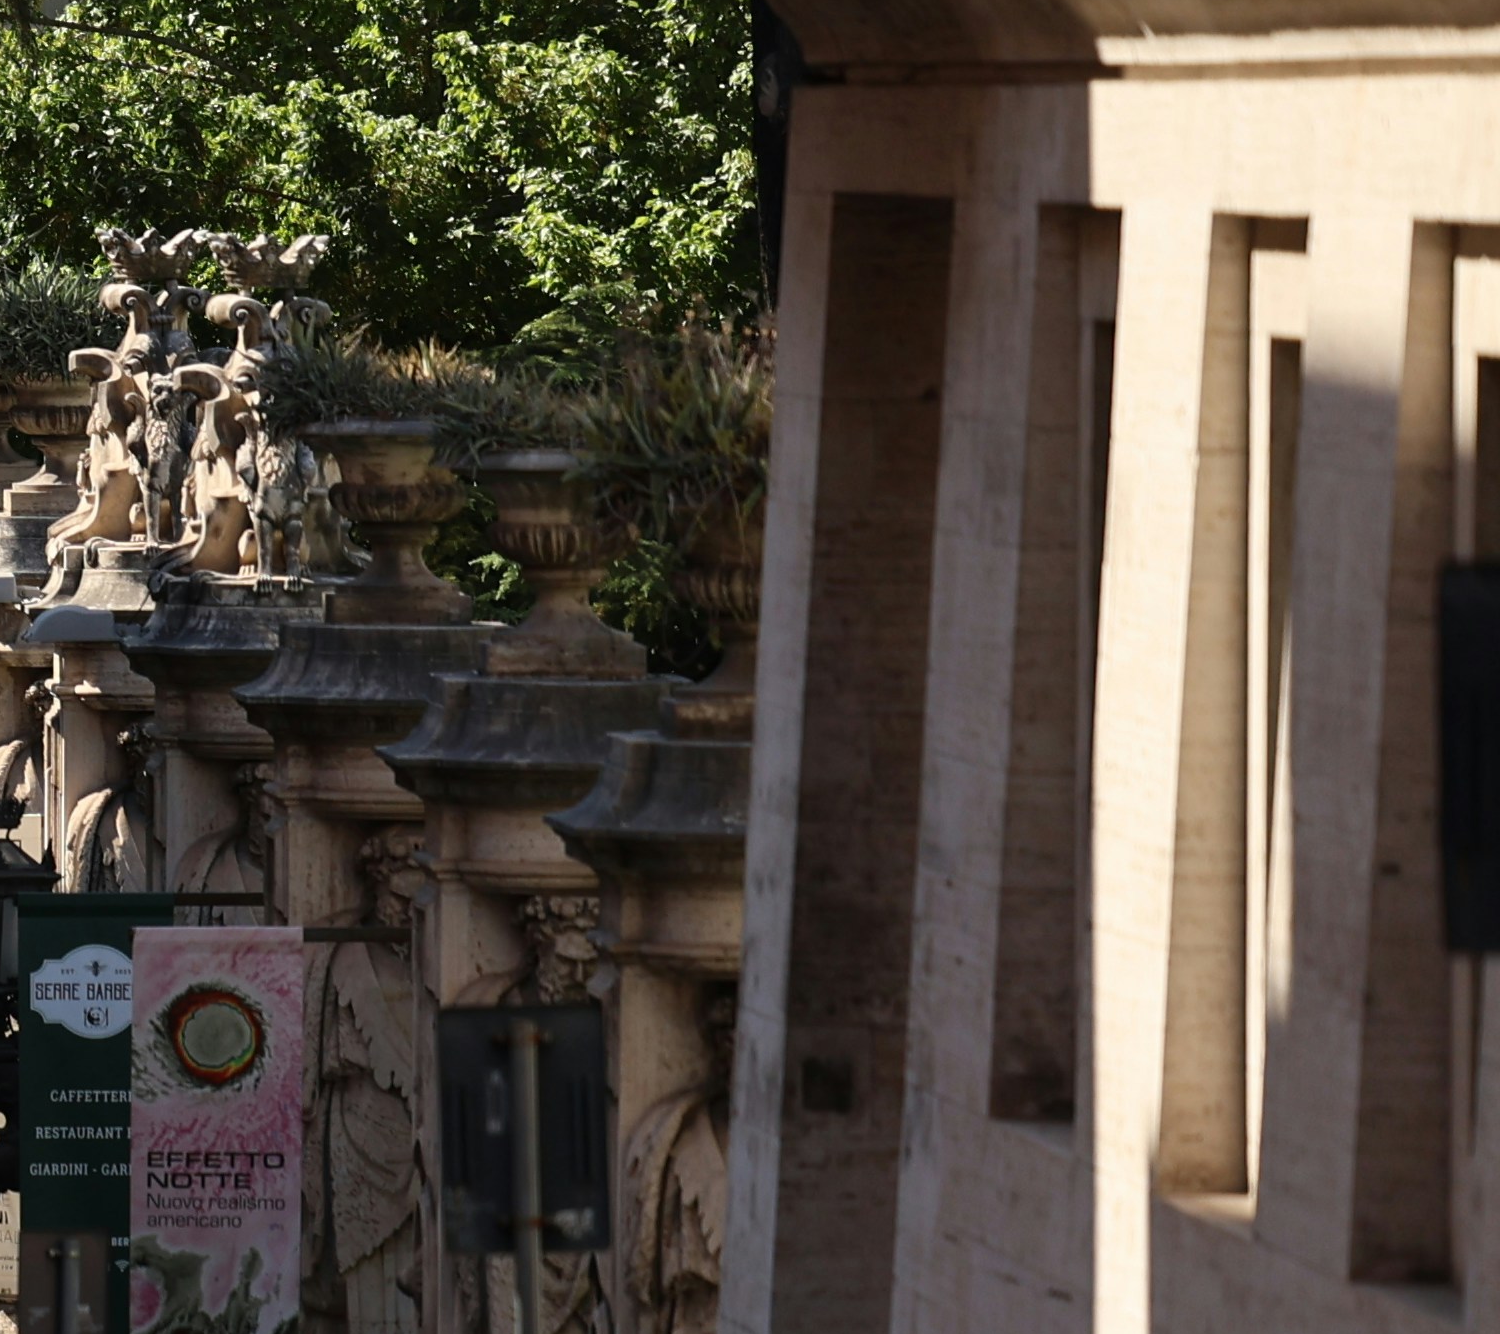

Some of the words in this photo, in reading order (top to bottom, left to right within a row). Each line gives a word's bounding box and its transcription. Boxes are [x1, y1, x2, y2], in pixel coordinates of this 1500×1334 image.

[35, 982, 80, 1001] SERRE
[35, 1126, 123, 1140] RESTAURANT
[147, 1151, 285, 1169] EFFETTO
[29, 1163, 89, 1177] GIARDINI
[147, 1172, 252, 1189] NOTTE
[146, 1192, 203, 1210] Nuovo
[209, 1193, 286, 1211] realismo
[147, 1214, 242, 1229] americano
